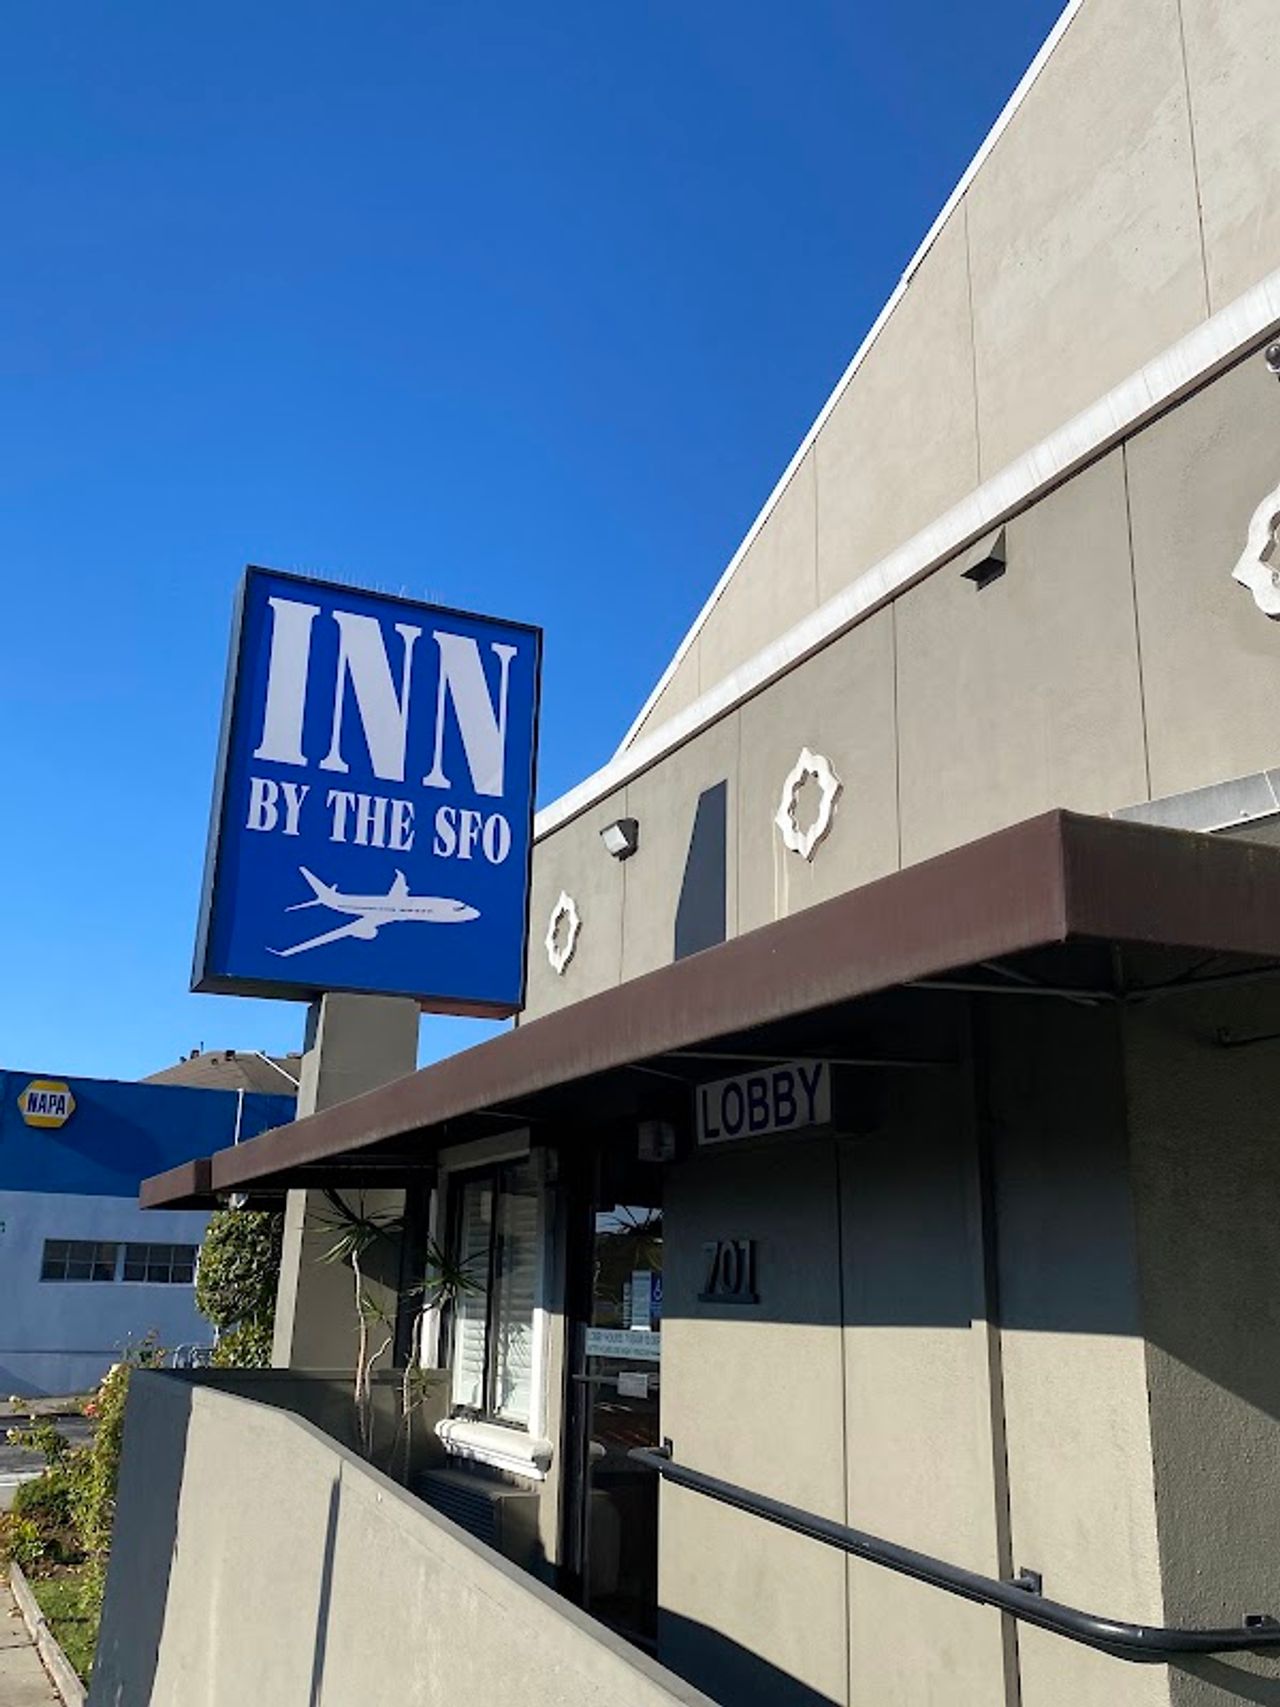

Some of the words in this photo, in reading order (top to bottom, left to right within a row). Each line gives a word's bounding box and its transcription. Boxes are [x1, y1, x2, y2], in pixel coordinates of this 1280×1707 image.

[253, 596, 518, 797] INN
[246, 776, 311, 836] BY
[327, 789, 416, 851] THE
[433, 805, 512, 866] SFO
[26, 1092, 66, 1115] NAPA
[702, 1062, 823, 1139] LOBBY
[703, 1239, 757, 1295] 701
